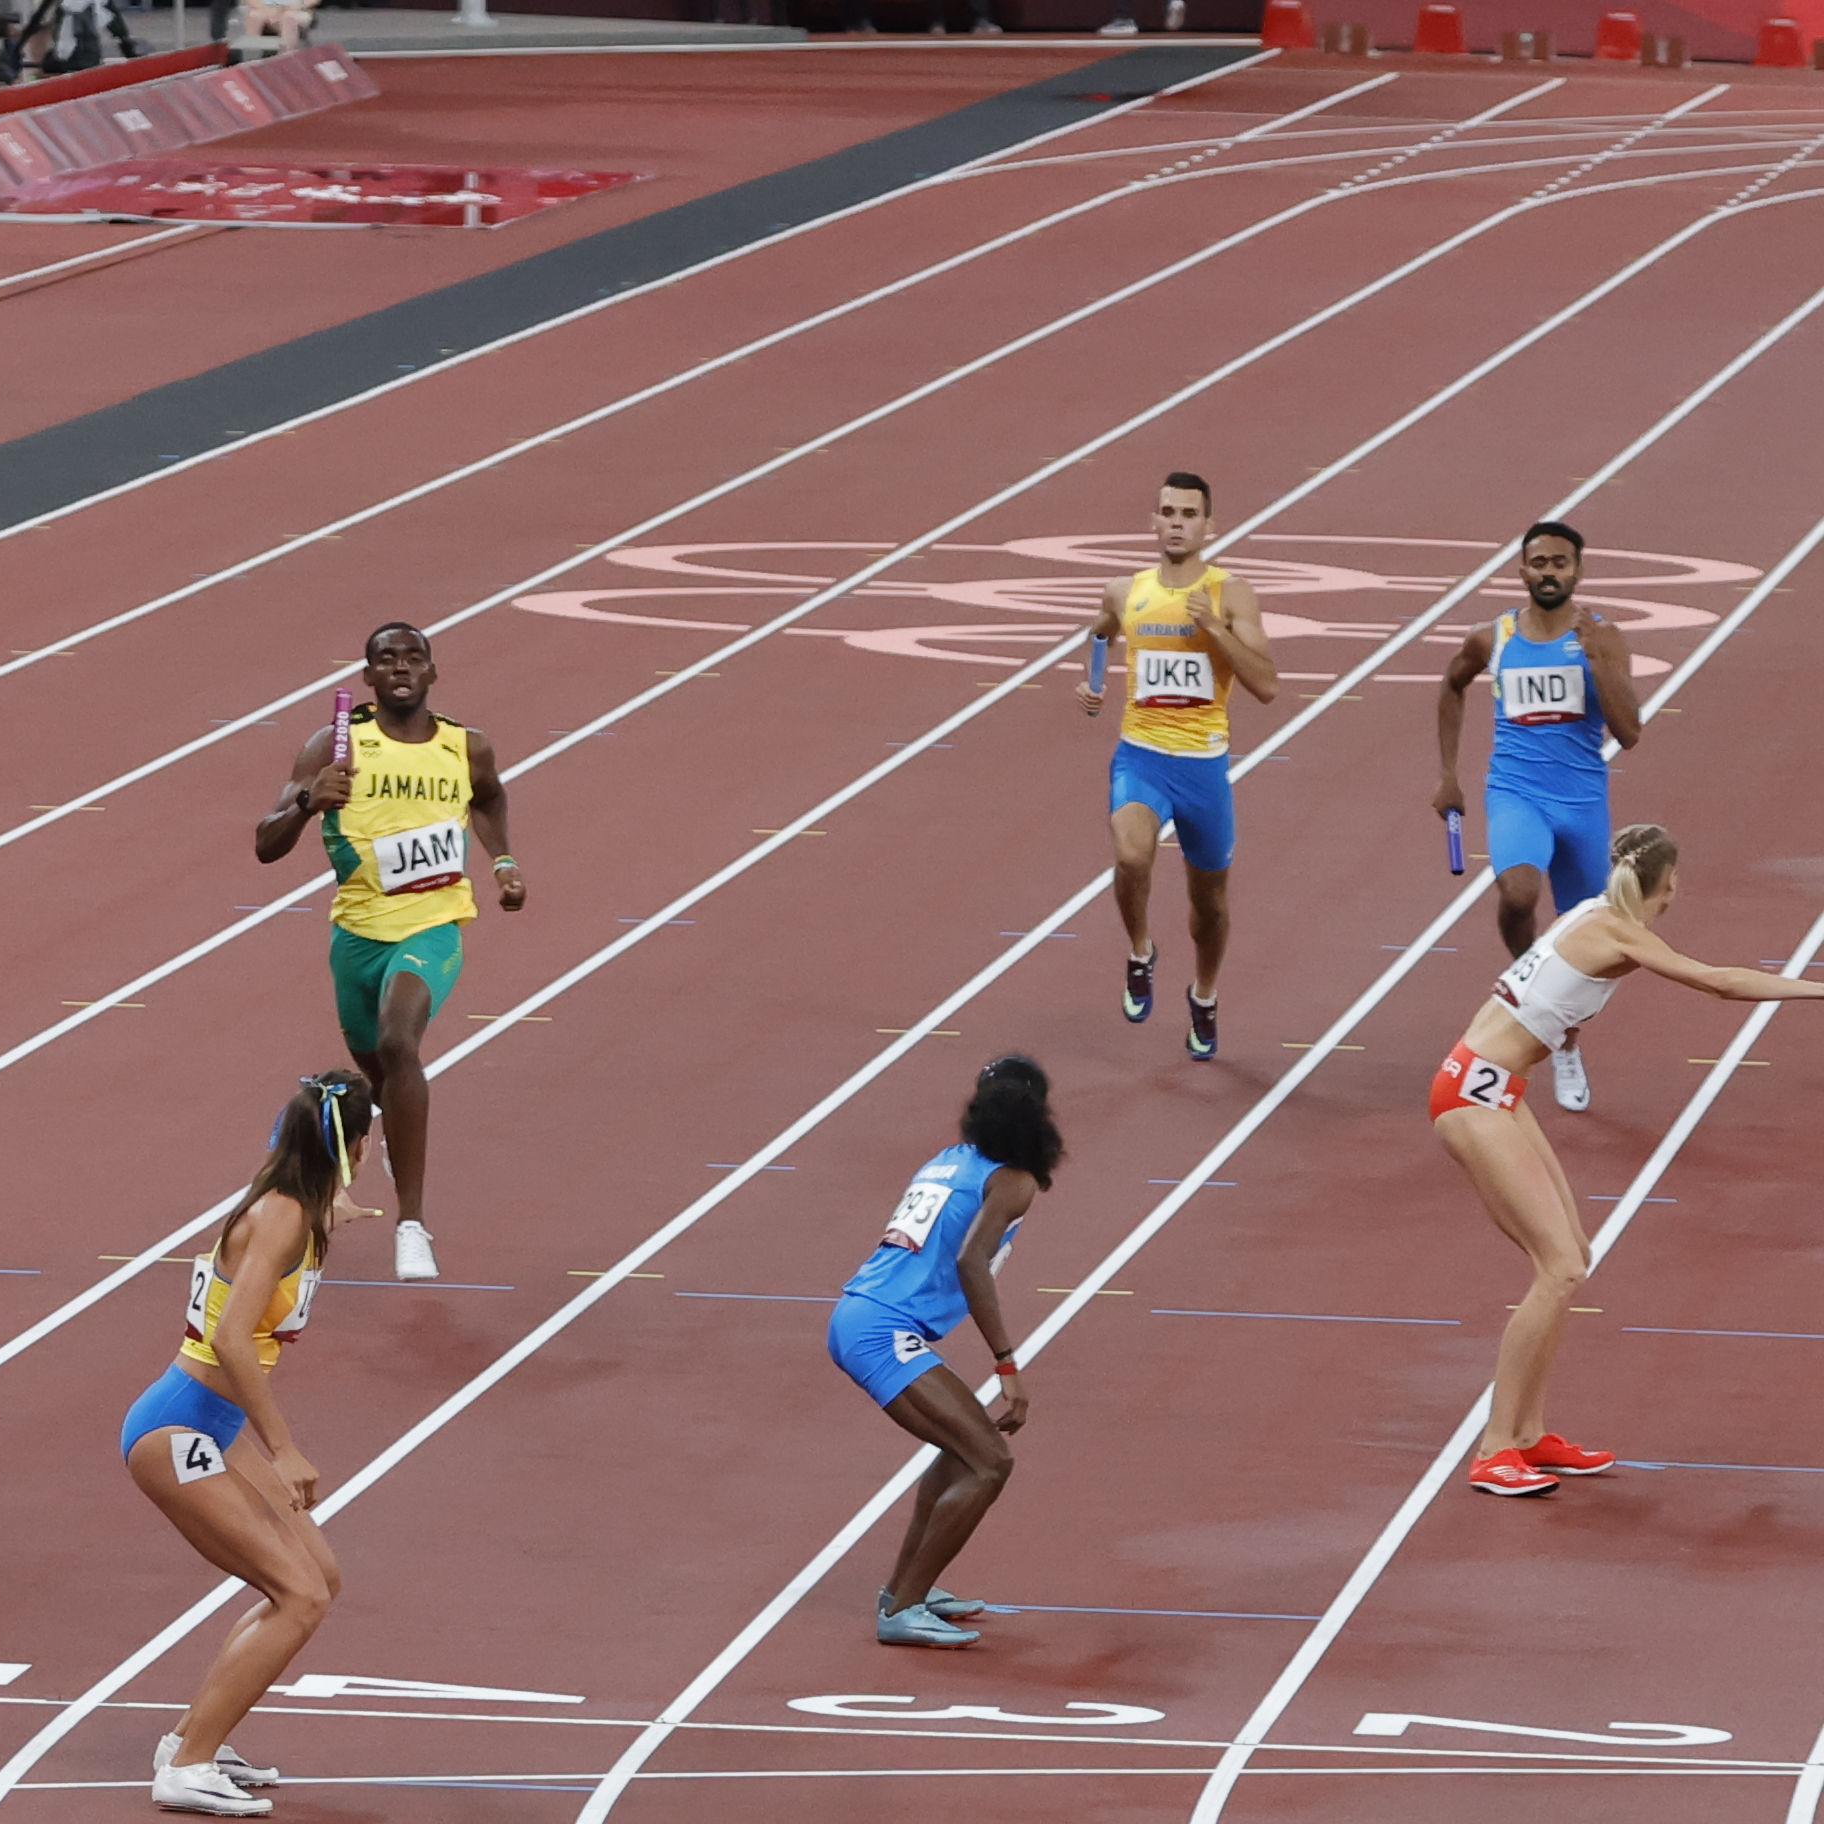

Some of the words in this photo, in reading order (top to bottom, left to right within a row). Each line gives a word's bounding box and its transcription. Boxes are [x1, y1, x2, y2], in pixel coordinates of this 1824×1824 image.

[1146, 658, 1202, 687] UKR
[1517, 674, 1567, 704] IND
[336, 711, 351, 742] 2020
[366, 774, 461, 804] JAMAICA
[392, 828, 459, 874] JAM
[1469, 1067, 1499, 1103] 2
[191, 1271, 206, 1312] 2
[904, 1334, 923, 1352] 3
[185, 1437, 213, 1472] 4
[266, 1673, 586, 1704] 4
[787, 1695, 1166, 1726] 3
[1353, 1712, 1733, 1746] 2
